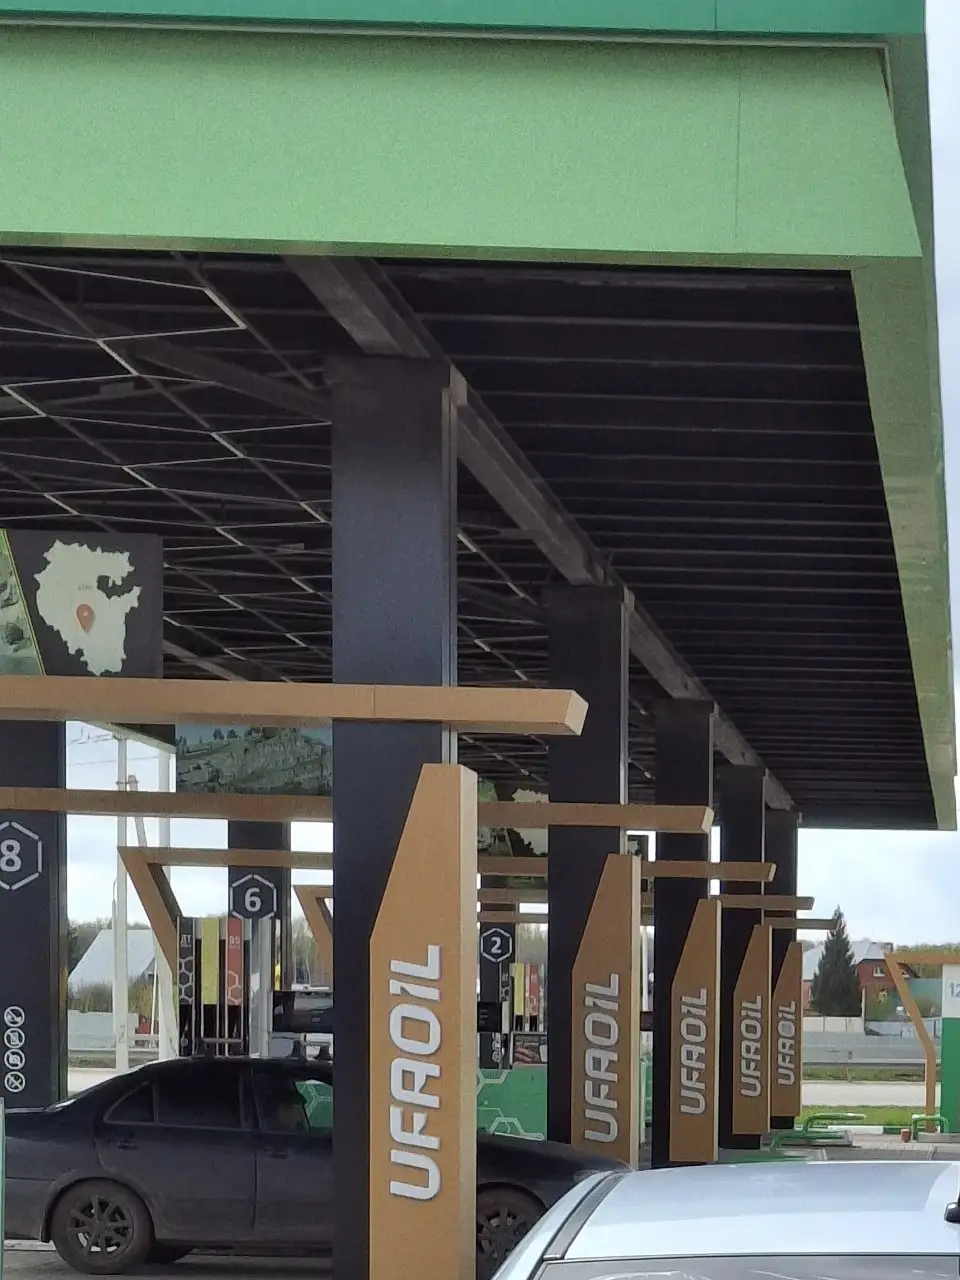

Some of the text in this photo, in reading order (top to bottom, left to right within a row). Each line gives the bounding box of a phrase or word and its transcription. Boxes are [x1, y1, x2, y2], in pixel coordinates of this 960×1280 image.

[1, 839, 22, 872] 8
[244, 887, 262, 912] 6
[490, 936, 502, 954] 2
[389, 944, 441, 1201] UFAOIL
[584, 973, 619, 1143] UFAOIL
[680, 988, 707, 1115] UFAOIL
[740, 995, 762, 1097] UFAOIL
[777, 1000, 796, 1086] UFAOIL
